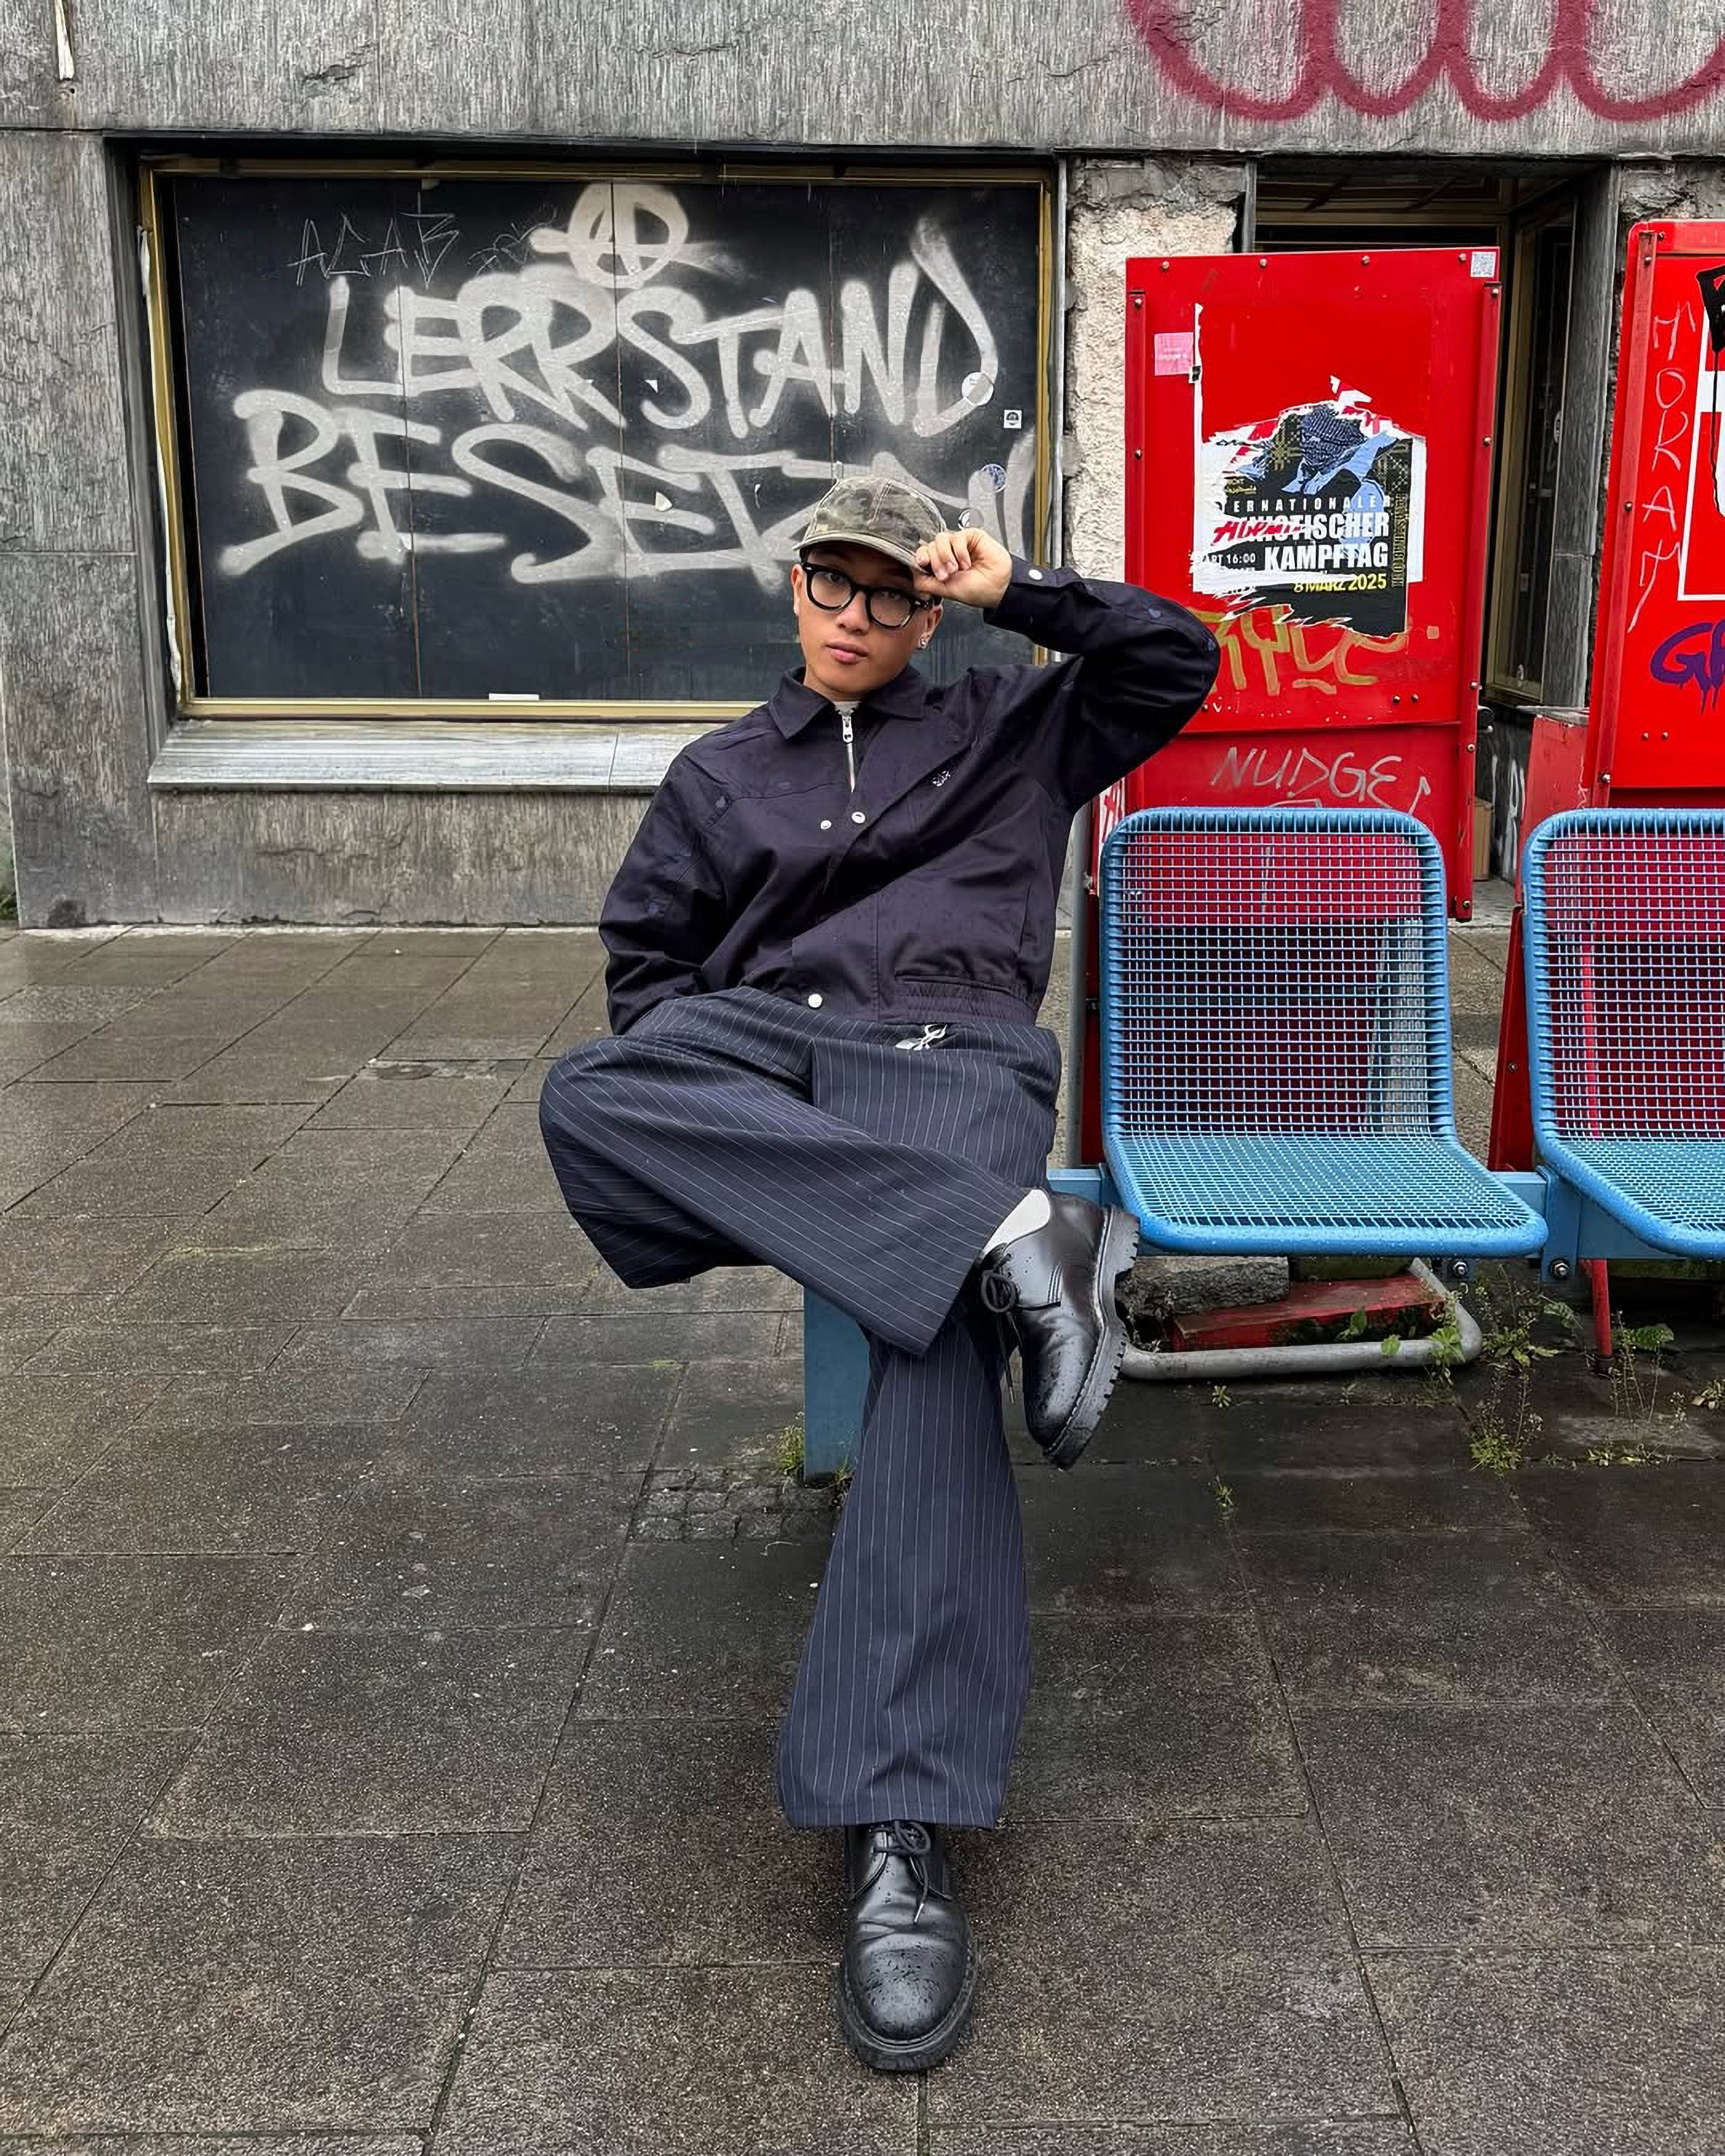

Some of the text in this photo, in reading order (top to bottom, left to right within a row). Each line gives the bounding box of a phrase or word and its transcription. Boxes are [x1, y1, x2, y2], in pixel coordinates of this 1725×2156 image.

[286, 191, 460, 290] ACAB
[1226, 553, 1256, 564] 16:00
[1265, 542, 1389, 571] KAMPFTAG
[1294, 582, 1304, 592] 8
[1348, 573, 1387, 591] 2025
[1209, 747, 1402, 808] NUDGE
